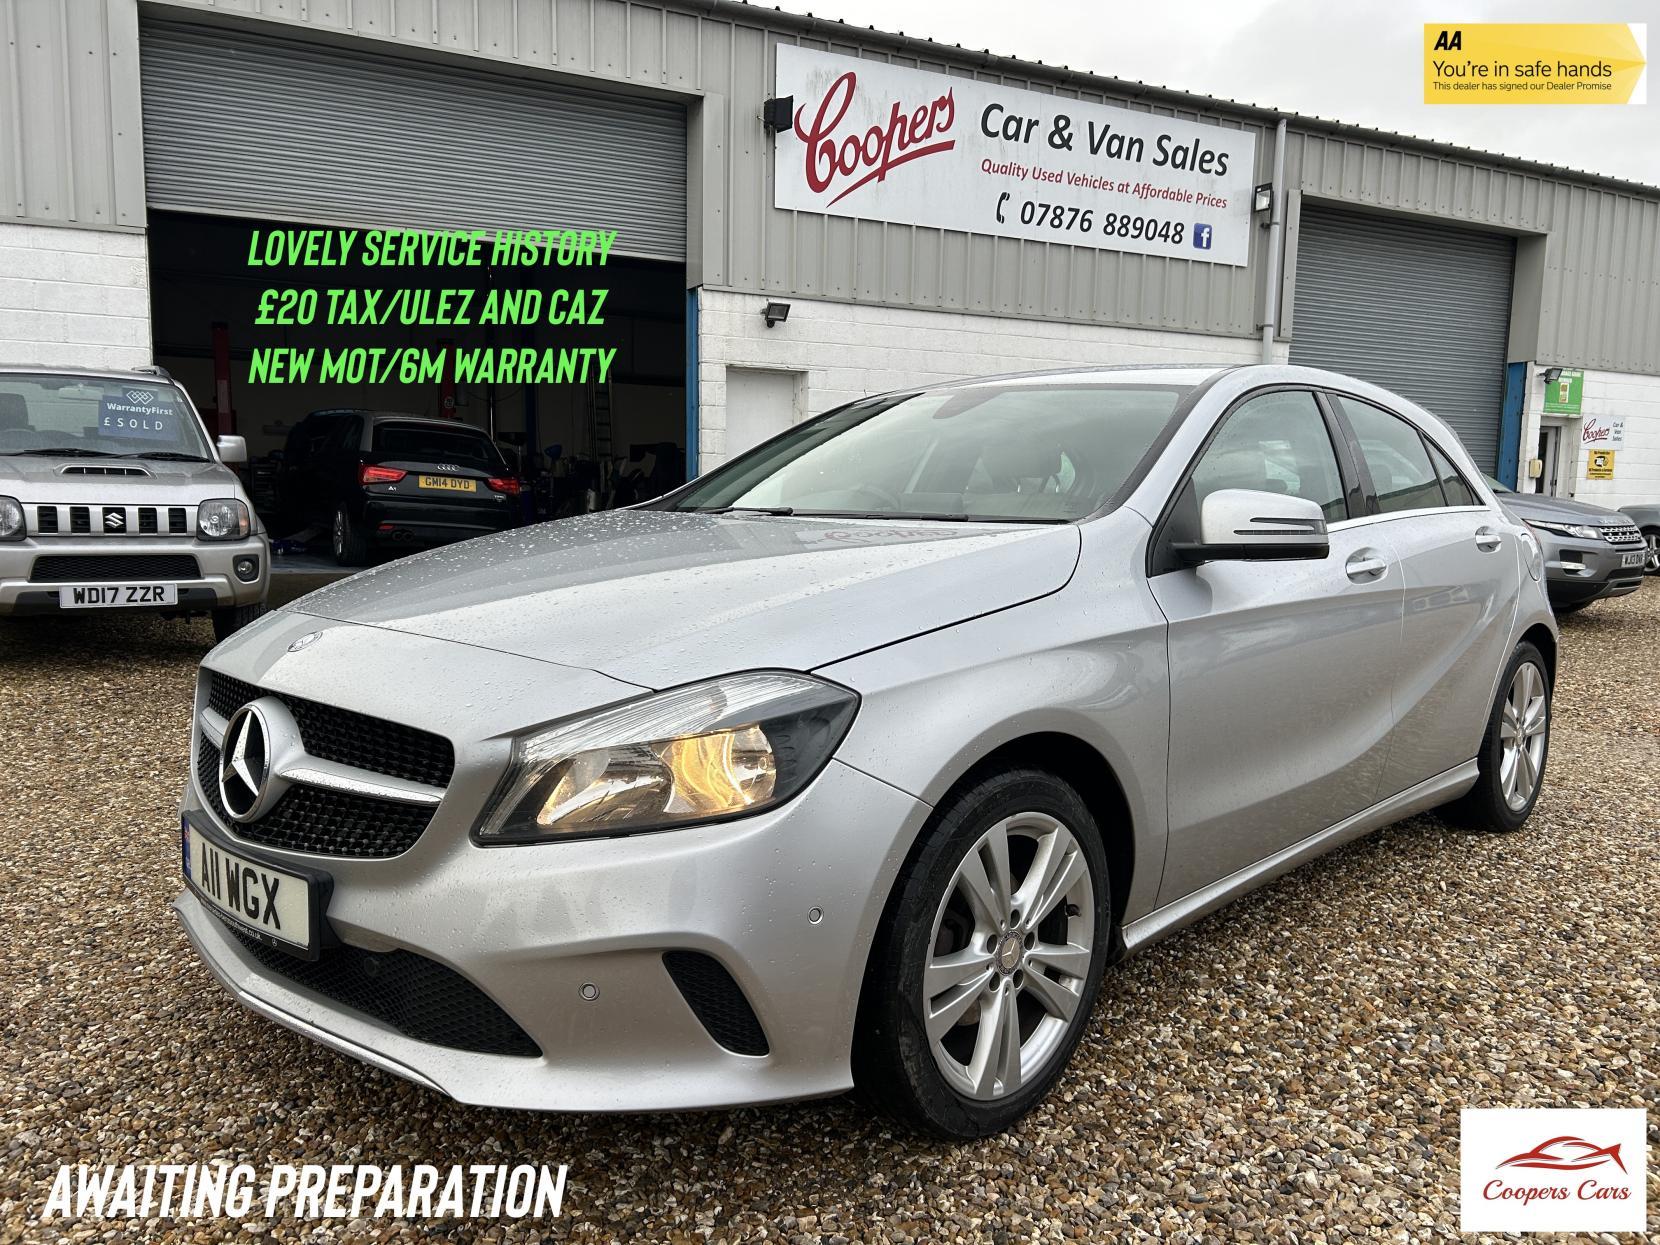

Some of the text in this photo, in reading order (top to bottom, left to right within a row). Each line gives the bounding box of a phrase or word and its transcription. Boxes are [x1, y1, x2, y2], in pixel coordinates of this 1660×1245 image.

[794, 71, 956, 207] Coopers
[980, 103, 1230, 176] Car & Van Sales
[981, 158, 1228, 209] Quality Used Vehicles at Affordable Prices
[1020, 200, 1185, 245] 07876 889048
[106, 402, 173, 416] WarrantyFirst
[425, 477, 470, 489] GM14 DYD
[73, 585, 165, 604] WD17 ZZR
[201, 842, 221, 900] A11
[225, 857, 281, 930] WGX
